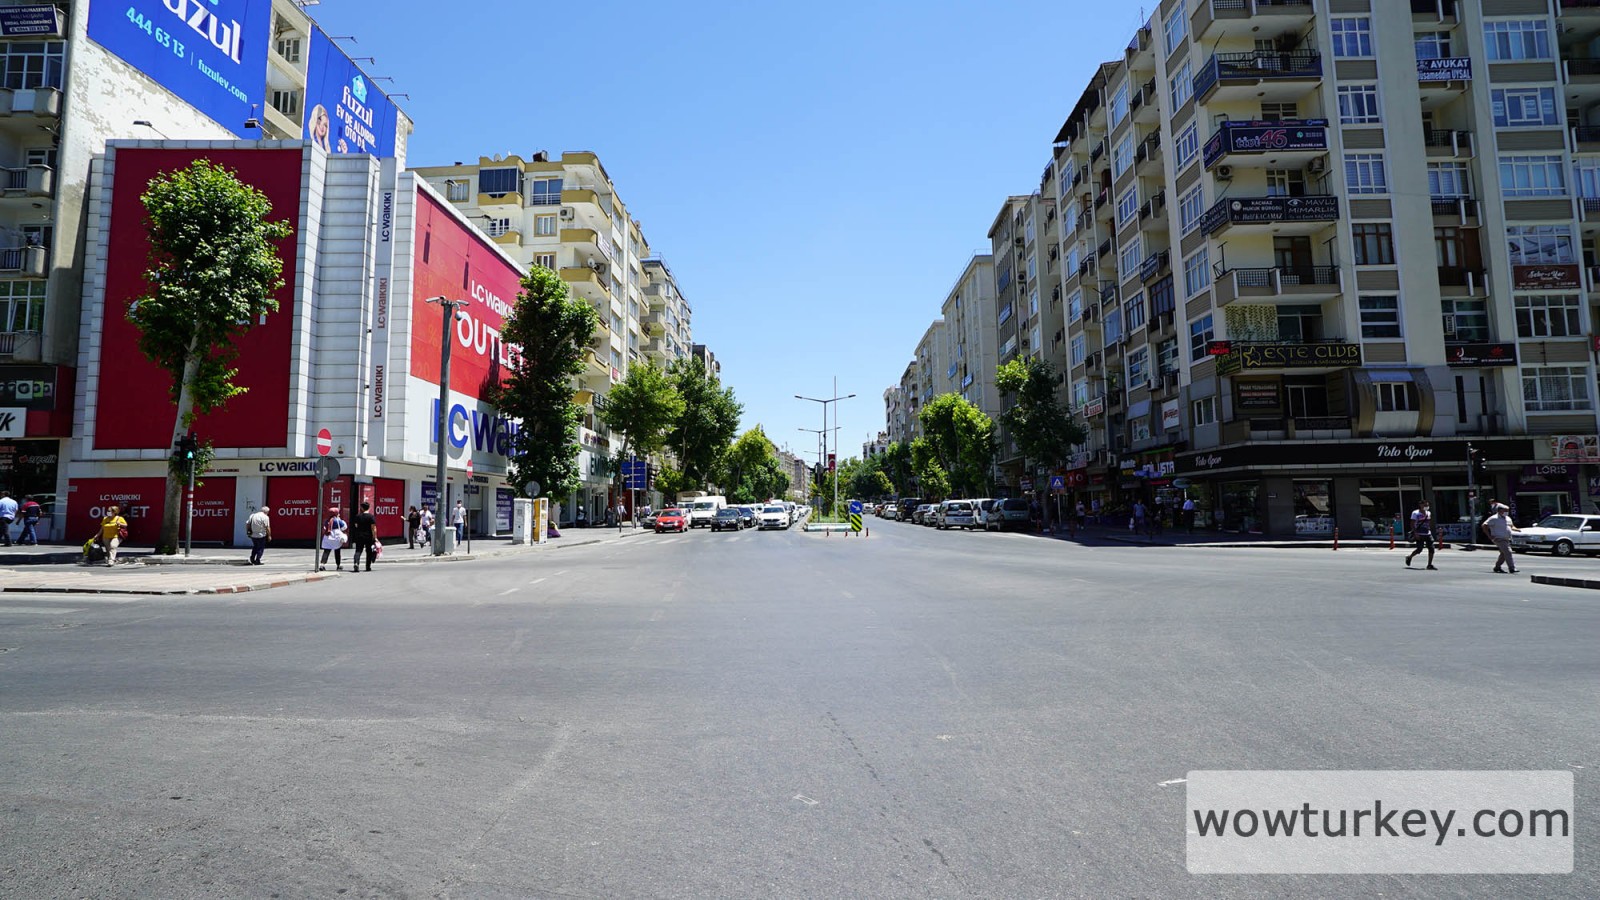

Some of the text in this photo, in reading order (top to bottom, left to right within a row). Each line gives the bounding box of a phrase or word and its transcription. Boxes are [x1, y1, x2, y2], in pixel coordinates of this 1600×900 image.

[126, 7, 185, 58] 444 63 13
[1430, 60, 1468, 68] AVUKAT
[198, 59, 248, 103] fuzulev.com
[342, 85, 373, 128] fuzul
[336, 104, 344, 119] EV
[345, 111, 353, 128] DE
[345, 125, 356, 143] OTO
[1235, 130, 1287, 148] tivi46
[382, 230, 389, 242] LC
[472, 280, 484, 303] LC
[1264, 346, 1358, 363] ESTE CLUB
[375, 406, 382, 417] LC
[1404, 445, 1433, 460] Spor
[260, 462, 274, 472] LC
[192, 508, 230, 517] OUTLET
[278, 507, 317, 516] OUTLET
[376, 506, 399, 515] OUTLET
